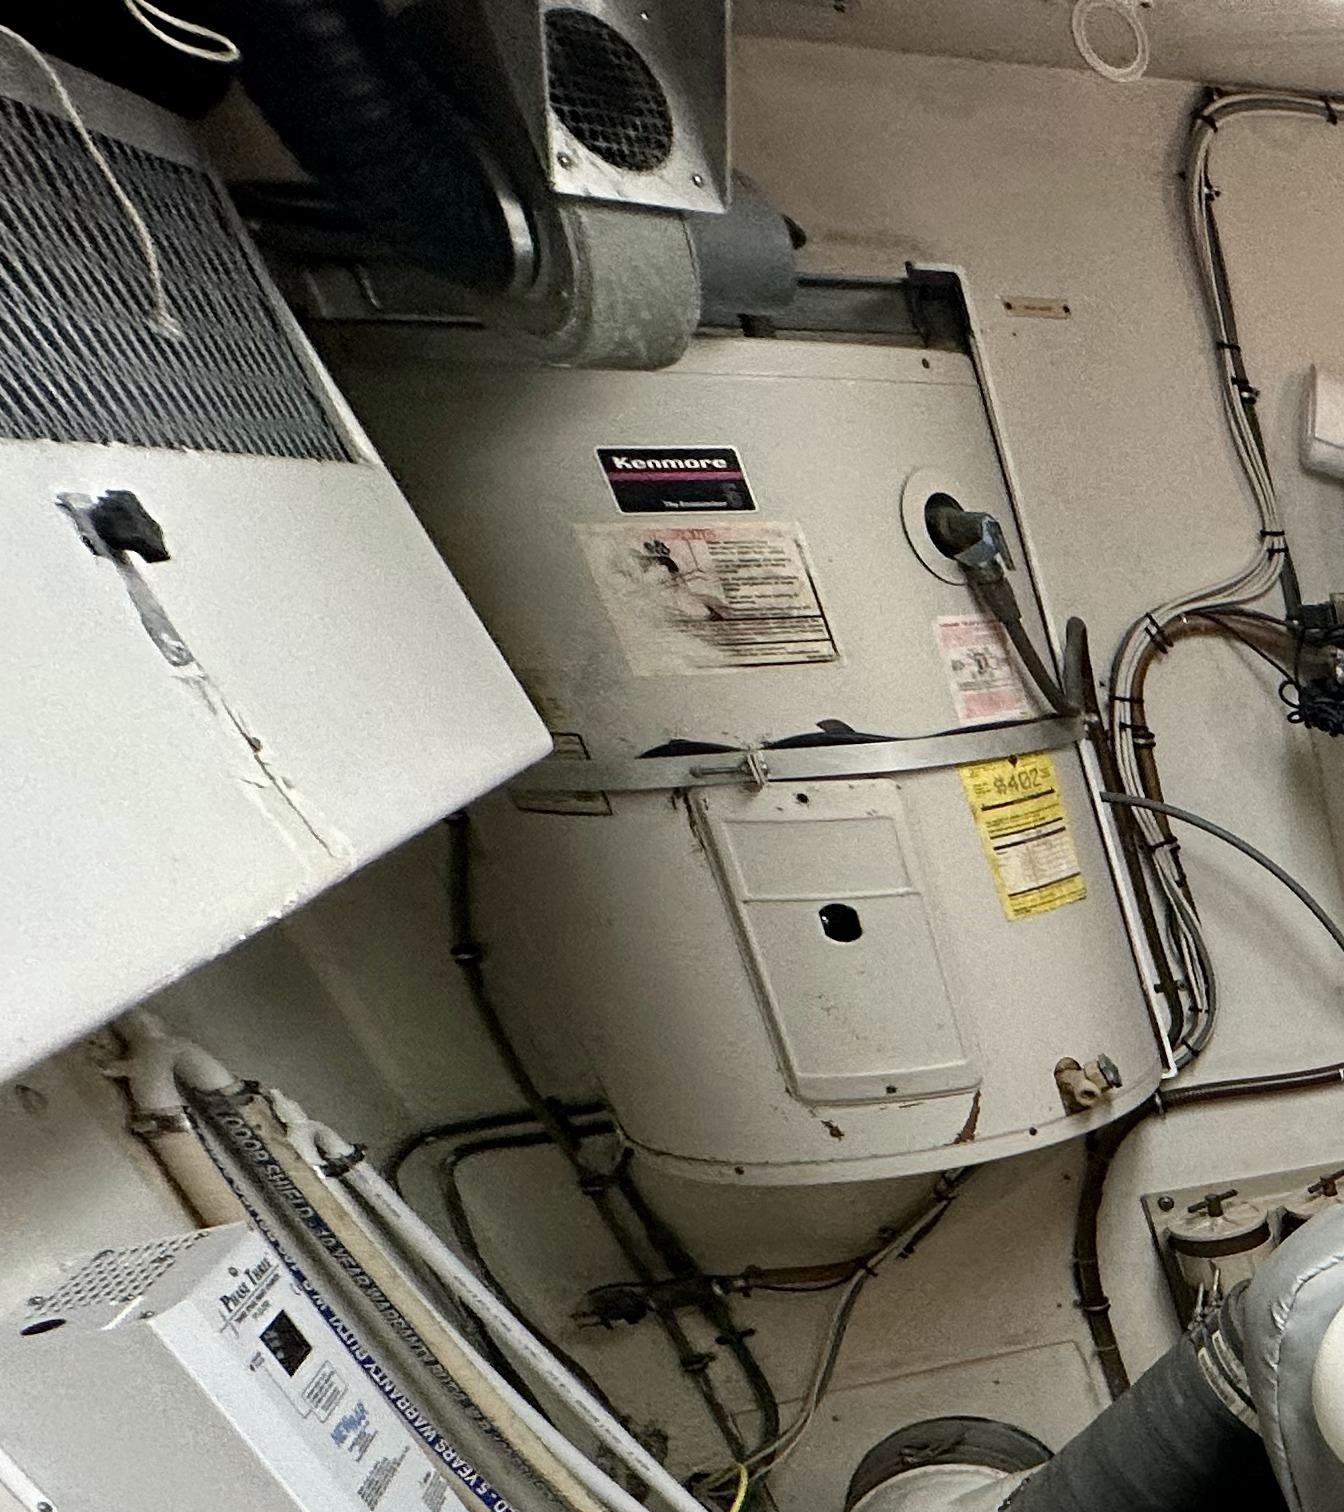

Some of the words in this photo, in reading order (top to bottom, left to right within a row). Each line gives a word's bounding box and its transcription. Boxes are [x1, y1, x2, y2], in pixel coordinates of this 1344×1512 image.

[611, 456, 728, 469] Kenmore
[364, 1361, 437, 1445] WARRANTY
[435, 1440, 482, 1487] YEARS
